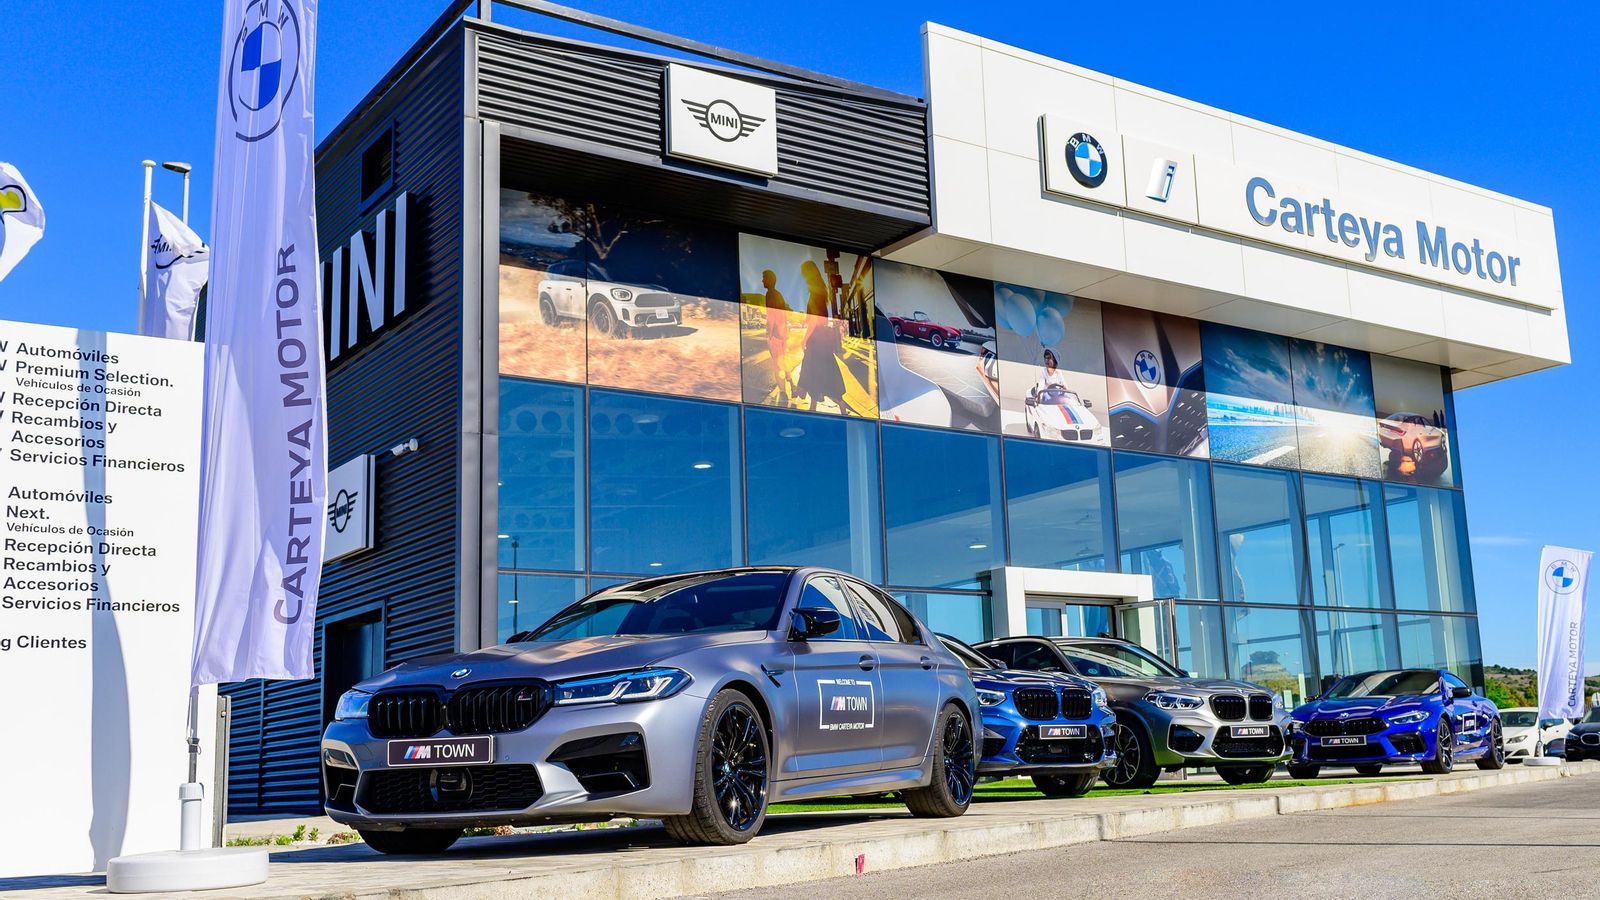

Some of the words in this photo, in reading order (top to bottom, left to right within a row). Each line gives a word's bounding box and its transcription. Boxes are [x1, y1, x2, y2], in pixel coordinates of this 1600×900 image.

[710, 113, 738, 129] MINI
[1069, 133, 1104, 155] BMW
[1245, 177, 1405, 262] Carteya
[1415, 220, 1521, 286] Motor
[320, 190, 407, 362] INI
[276, 243, 312, 408] MOTOR
[16, 343, 119, 364] Automóviles
[15, 361, 89, 381] Premium
[93, 368, 174, 387] Selection.
[16, 377, 74, 391] Vehículos
[76, 383, 92, 393] de
[94, 385, 141, 398] Ocasión
[13, 392, 100, 411] Recepción
[105, 401, 162, 417] Directa
[12, 411, 105, 430] Recambios
[108, 421, 117, 433] y
[11, 430, 105, 449] Accesorios
[10, 449, 87, 467] Servicios
[92, 454, 185, 473] Financieros
[8, 486, 113, 504] Automóviles
[6, 505, 50, 520] Next.
[272, 418, 313, 625] CARTEYA
[6, 522, 65, 535] Vehículos
[69, 525, 83, 535] de
[87, 526, 134, 537] Ocasión
[5, 538, 93, 555] Recepción
[98, 543, 157, 556] Directa
[3, 557, 97, 574] Recambios
[101, 564, 111, 576] y
[3, 577, 99, 592] Accesorios
[2, 596, 82, 610] Servicios
[86, 598, 180, 612] Financieros
[17, 635, 87, 649] Clientes
[1569, 621, 1578, 657] MOTOR
[1567, 661, 1577, 707] CARTEYA
[847, 696, 868, 711] TOWN
[1061, 728, 1080, 736] TOWN
[1249, 727, 1264, 735] TOWN
[433, 743, 475, 758] TOWN
